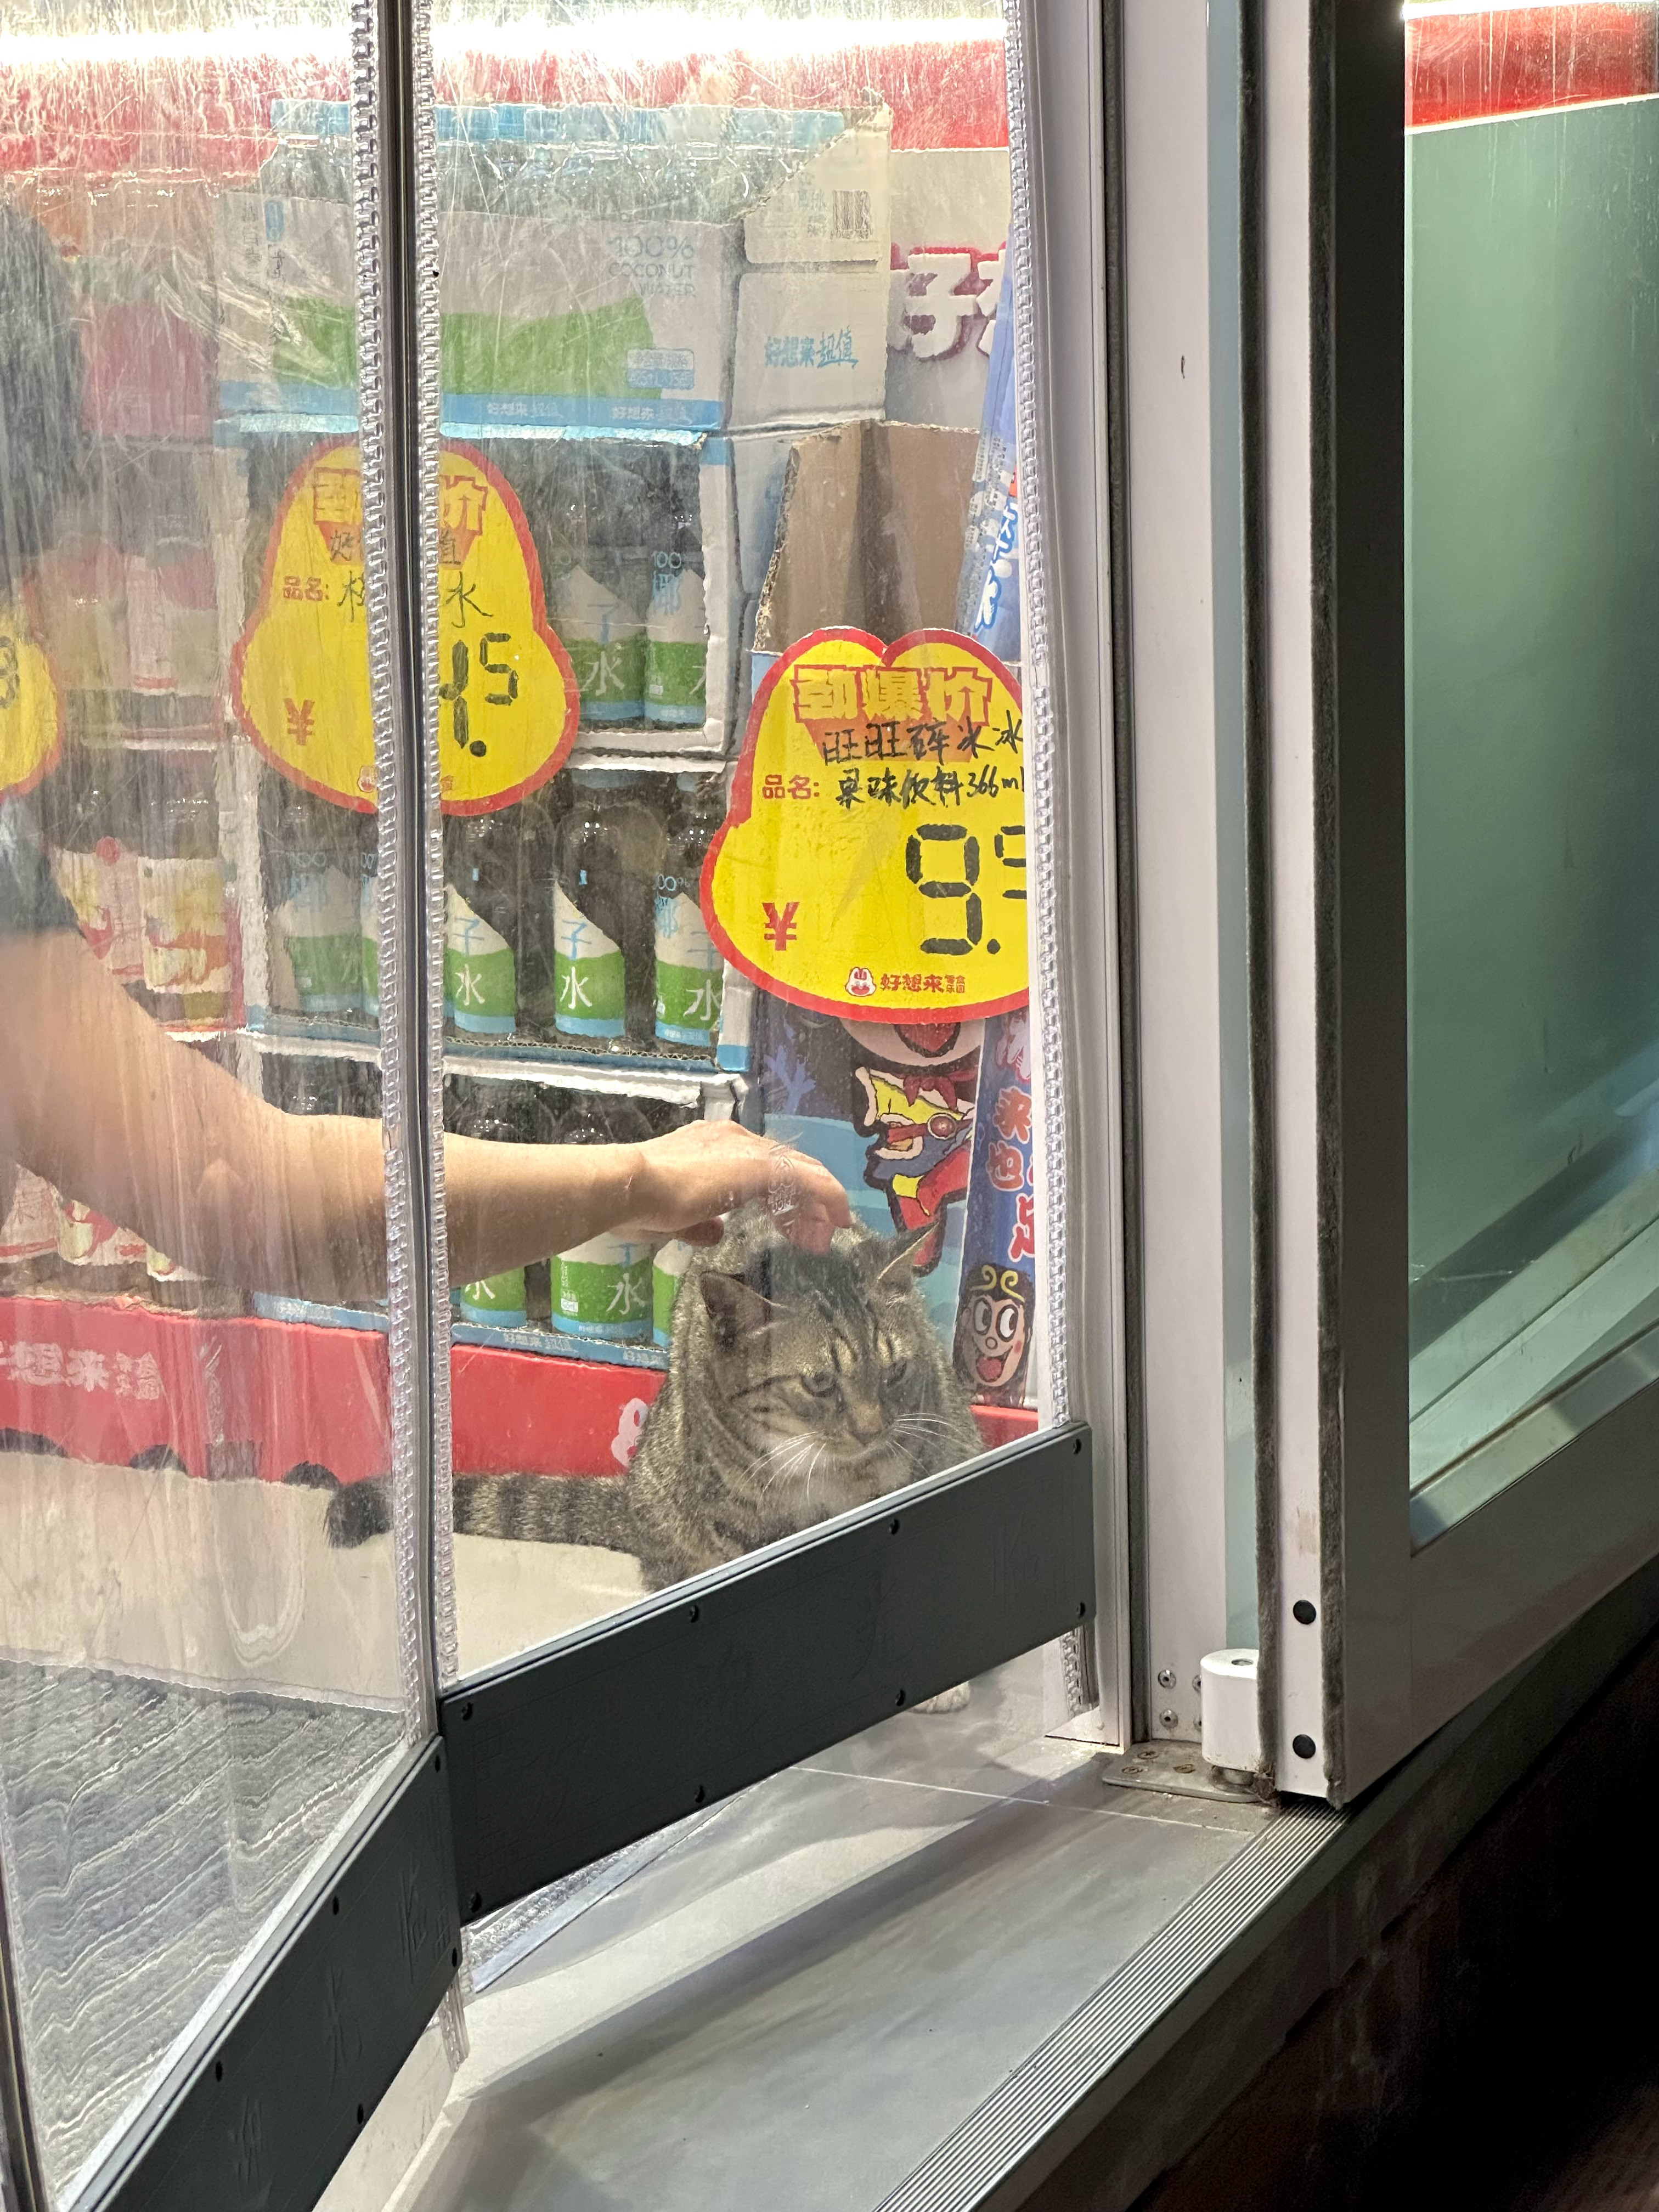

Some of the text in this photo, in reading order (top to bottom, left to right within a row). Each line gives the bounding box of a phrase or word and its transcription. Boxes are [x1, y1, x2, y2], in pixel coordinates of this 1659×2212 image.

[607, 235, 695, 259] 100%
[789, 664, 993, 727] 劲爆价
[880, 973, 944, 994] 好想来
[0, 1340, 110, 1392] 想来
